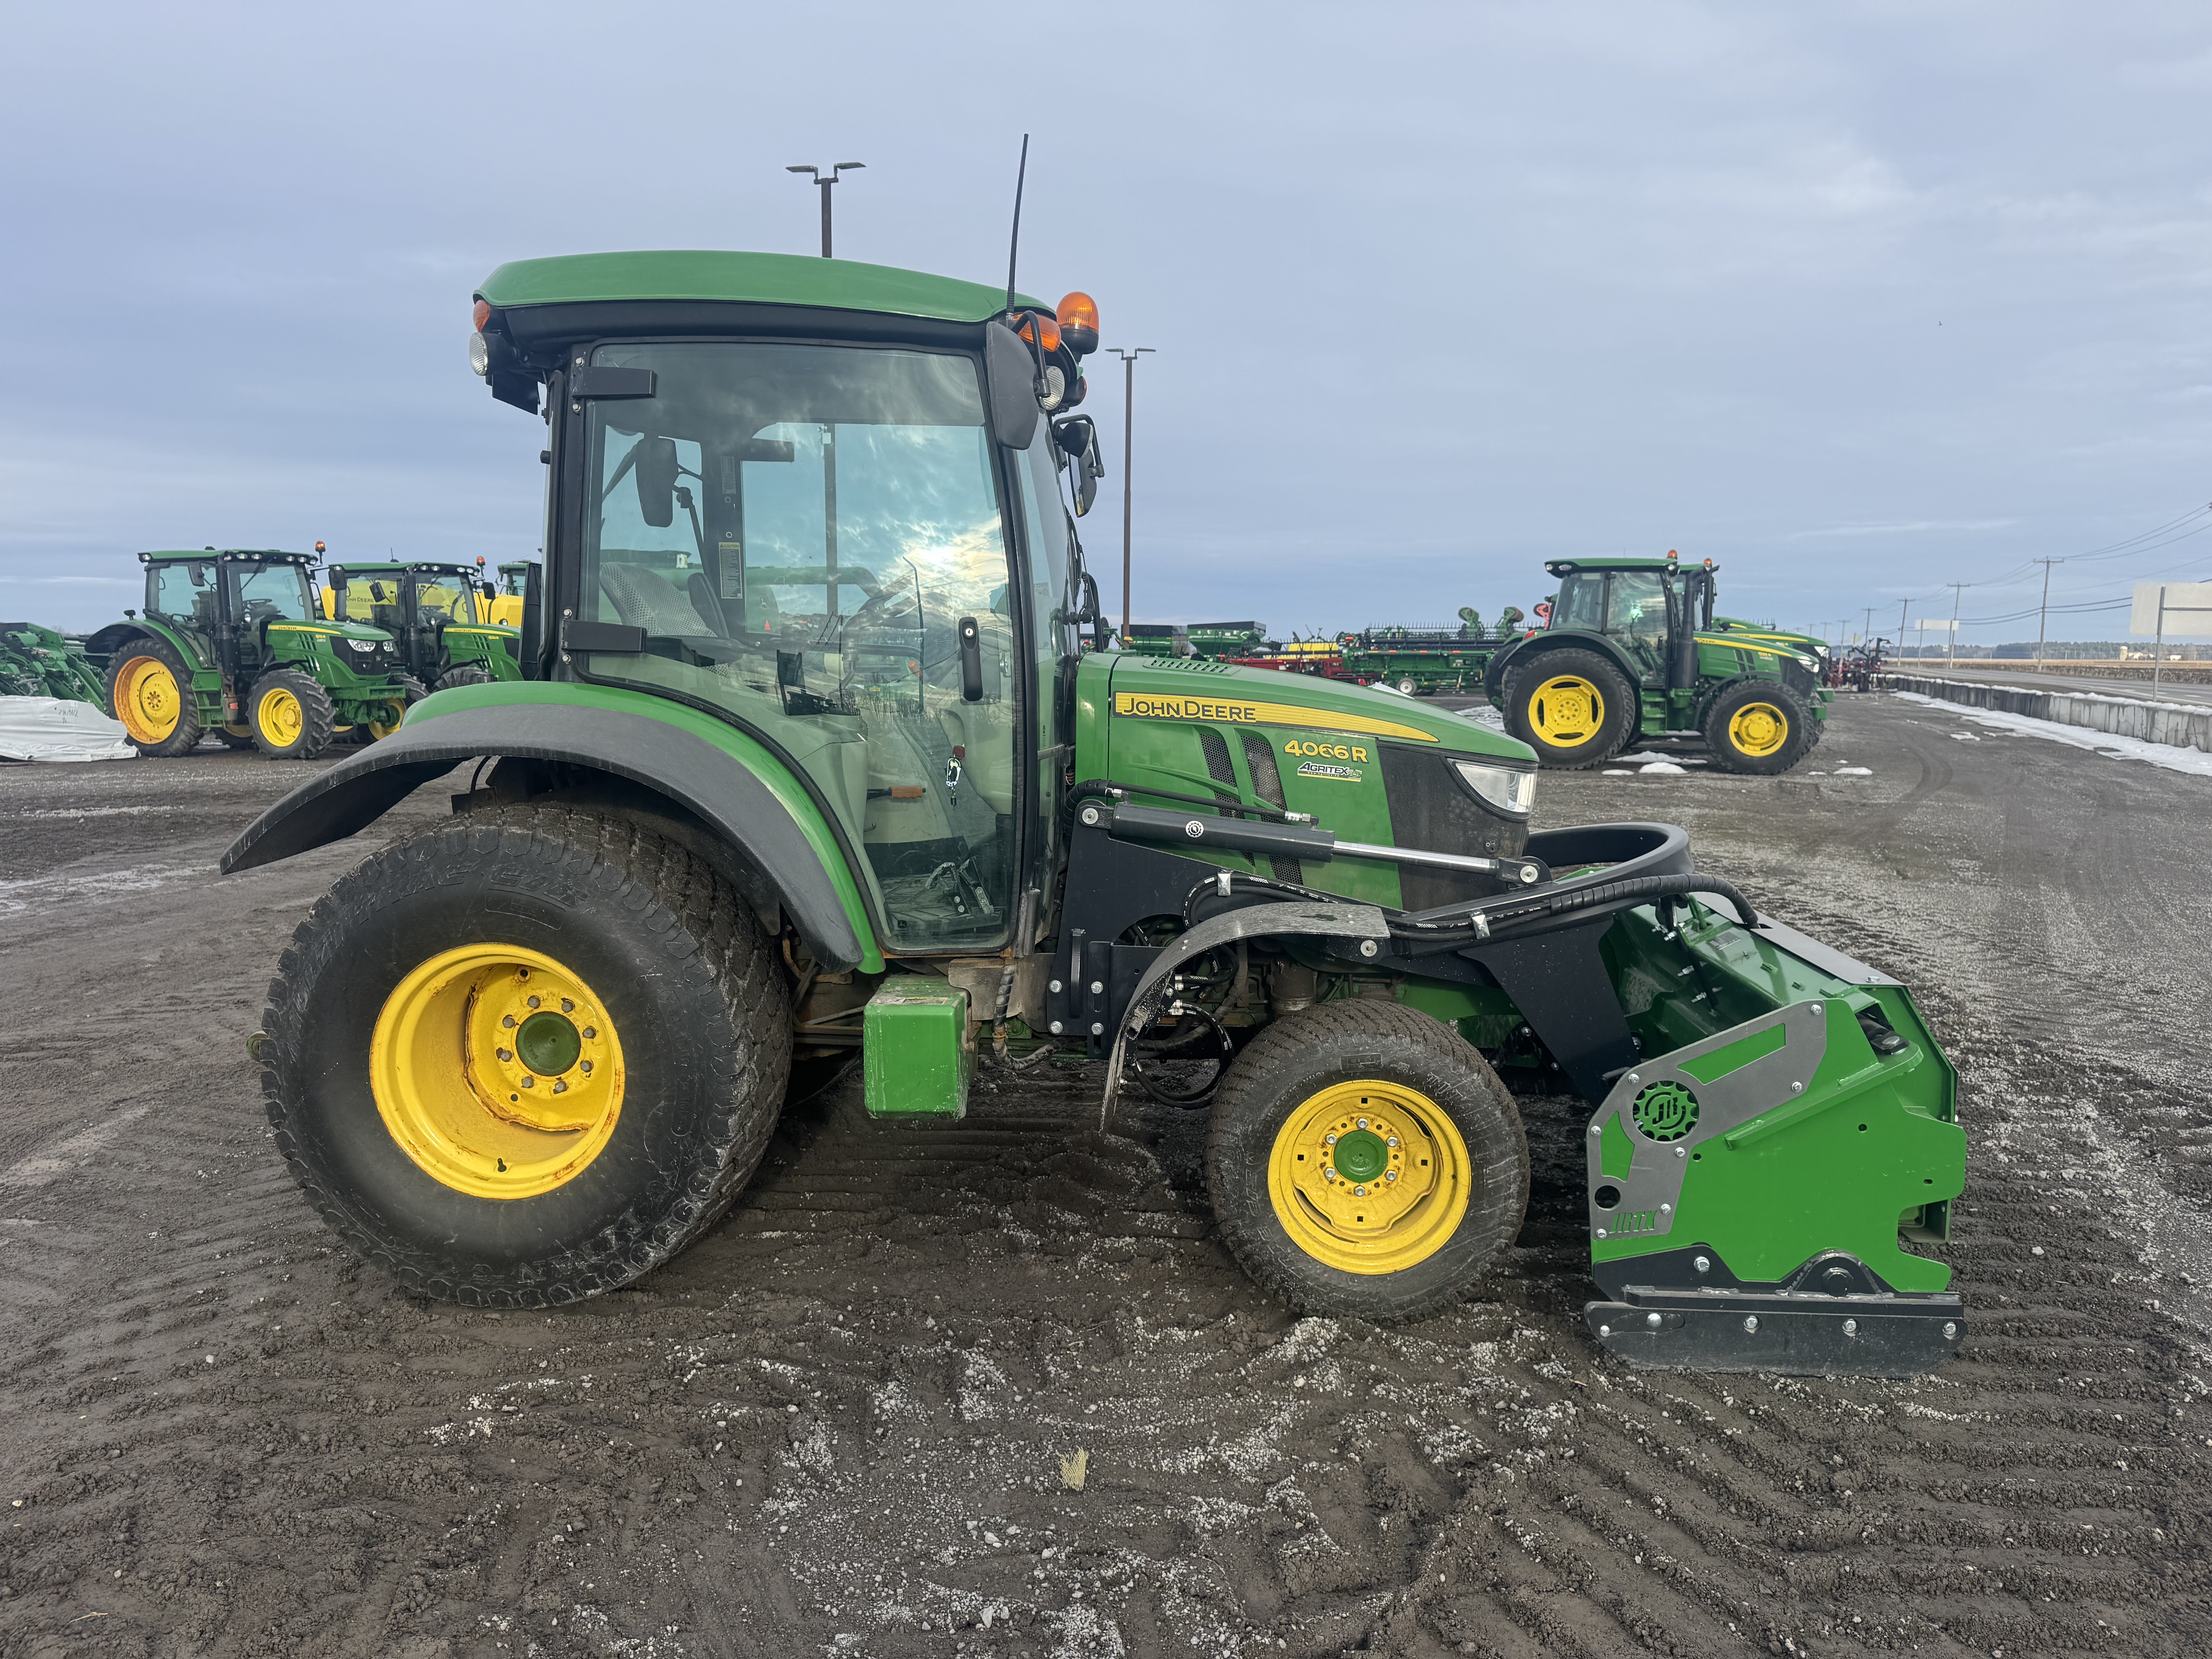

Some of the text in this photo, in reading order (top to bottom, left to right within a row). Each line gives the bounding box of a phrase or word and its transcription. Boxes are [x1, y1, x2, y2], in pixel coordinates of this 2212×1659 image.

[1124, 697, 1256, 721] JOHN DEERE
[1299, 763, 1348, 775] AGRITEX
